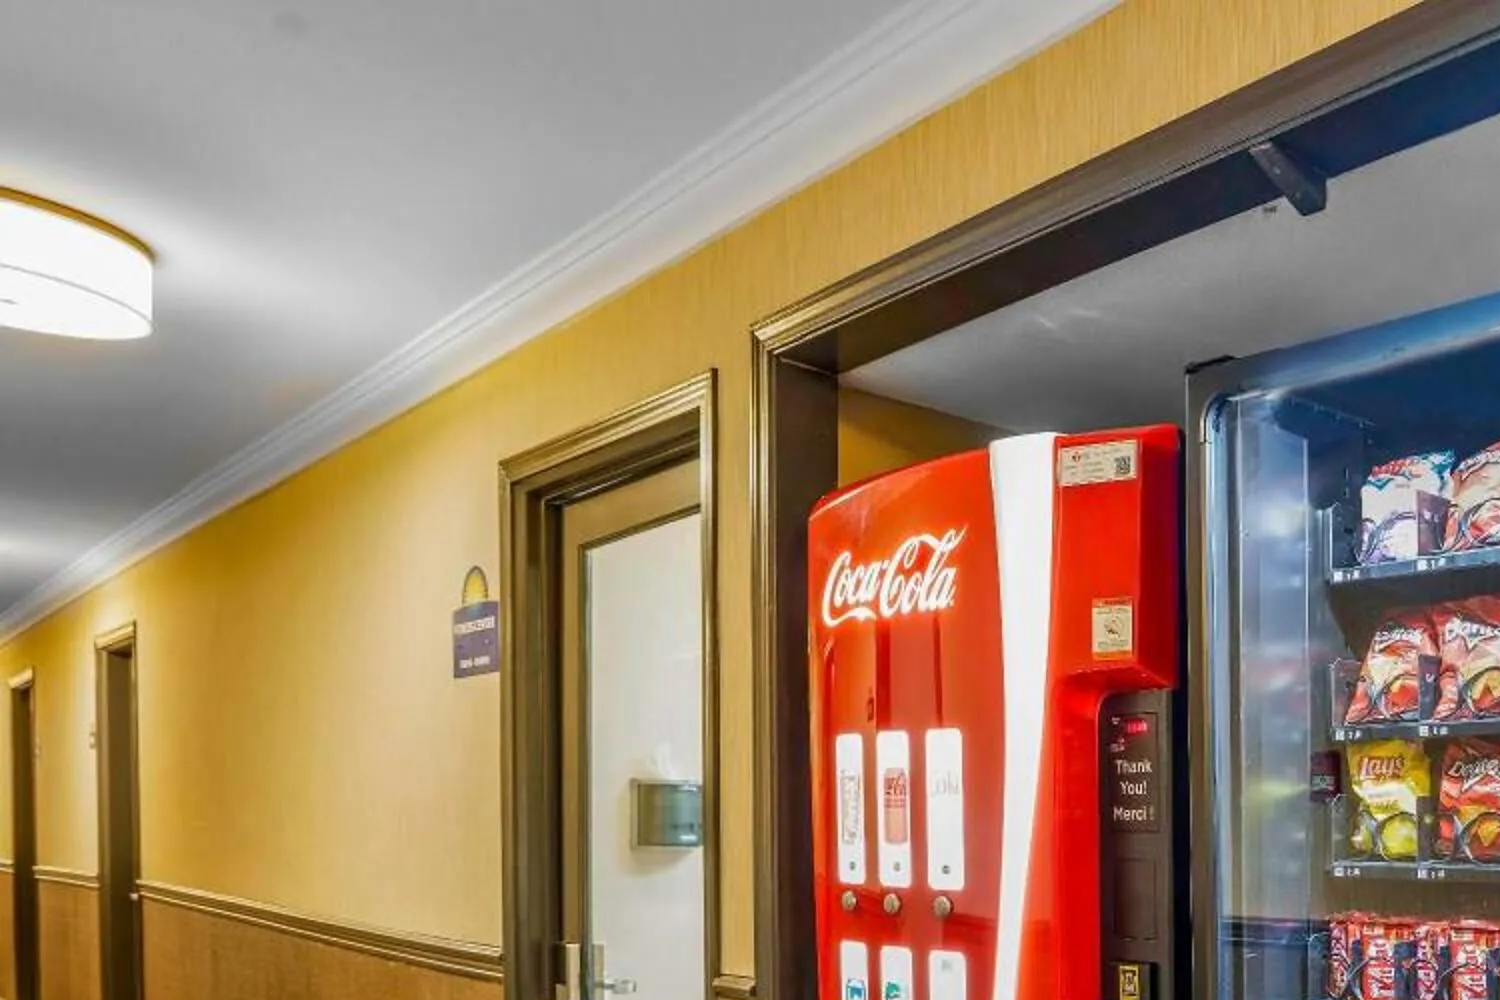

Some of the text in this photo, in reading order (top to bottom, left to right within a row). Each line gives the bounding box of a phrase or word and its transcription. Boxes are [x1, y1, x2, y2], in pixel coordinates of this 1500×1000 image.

[822, 523, 968, 629] Coca-Cola
[1115, 759, 1153, 775] Thank
[1120, 781, 1148, 795] You!
